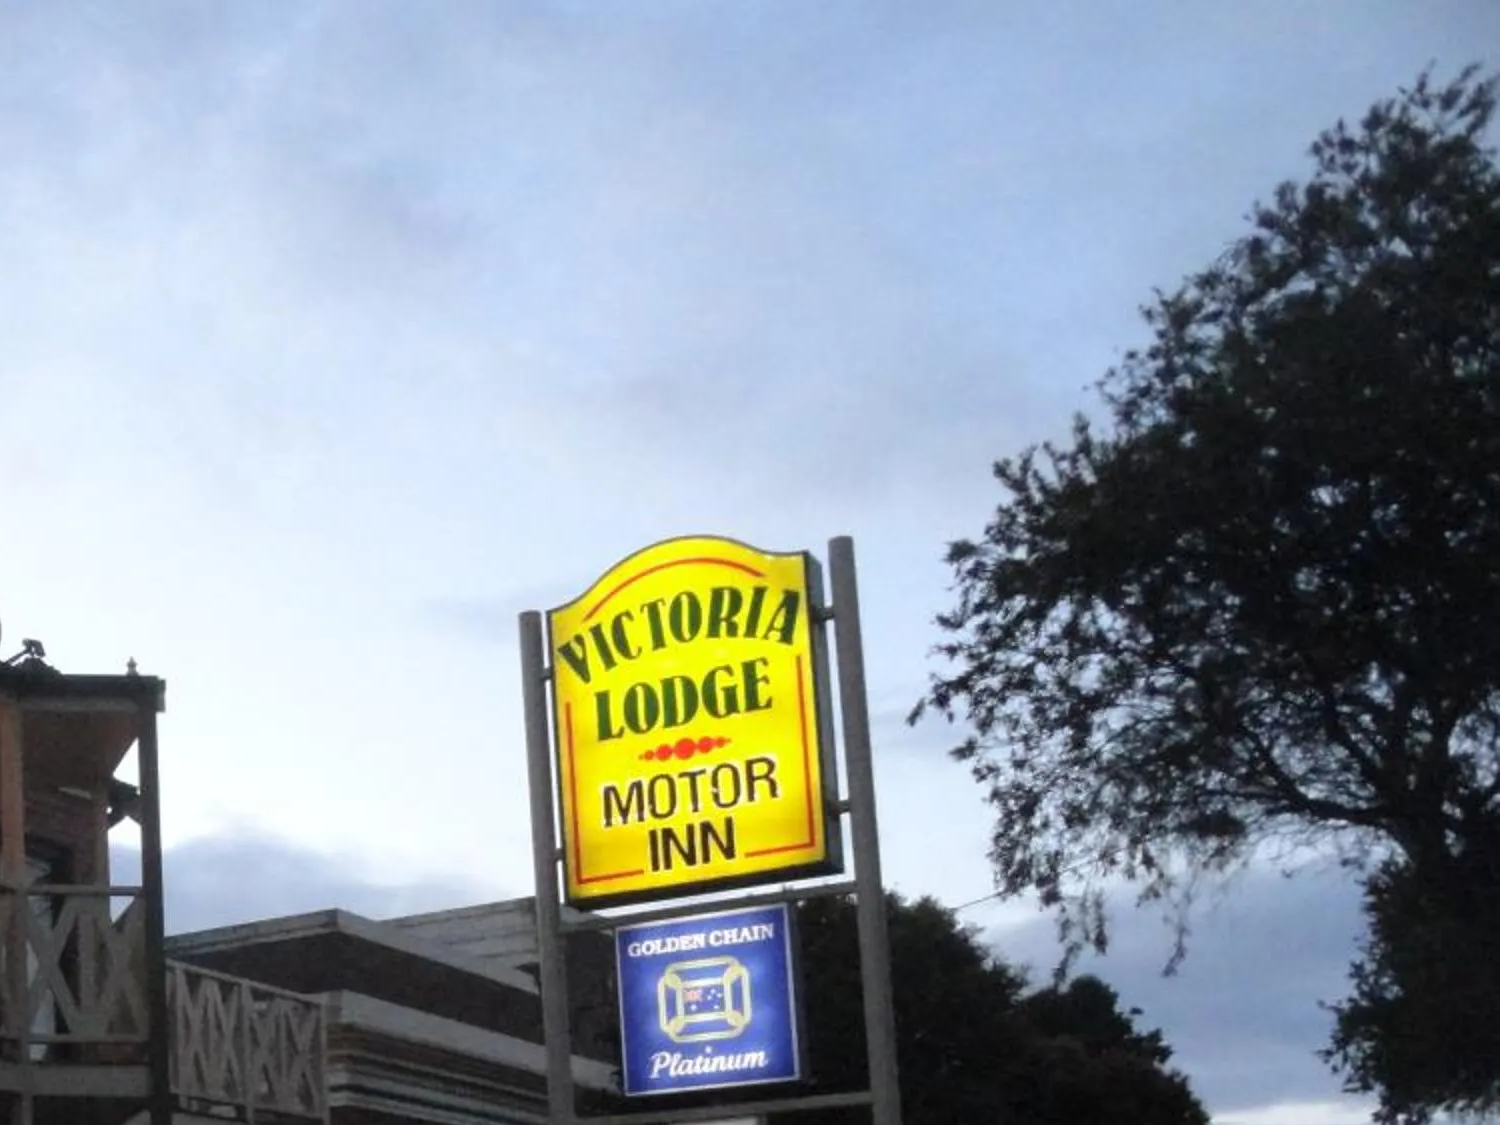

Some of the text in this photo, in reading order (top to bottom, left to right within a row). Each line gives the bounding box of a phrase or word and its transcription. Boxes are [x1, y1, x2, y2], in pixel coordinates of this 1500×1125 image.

[558, 586, 799, 684] VICTORIA
[594, 657, 773, 741] LODGE
[603, 757, 779, 827] MOTOR
[649, 817, 736, 871] INN
[628, 923, 775, 957] GOLDEN CHAIN
[651, 1047, 766, 1078] Platinum
